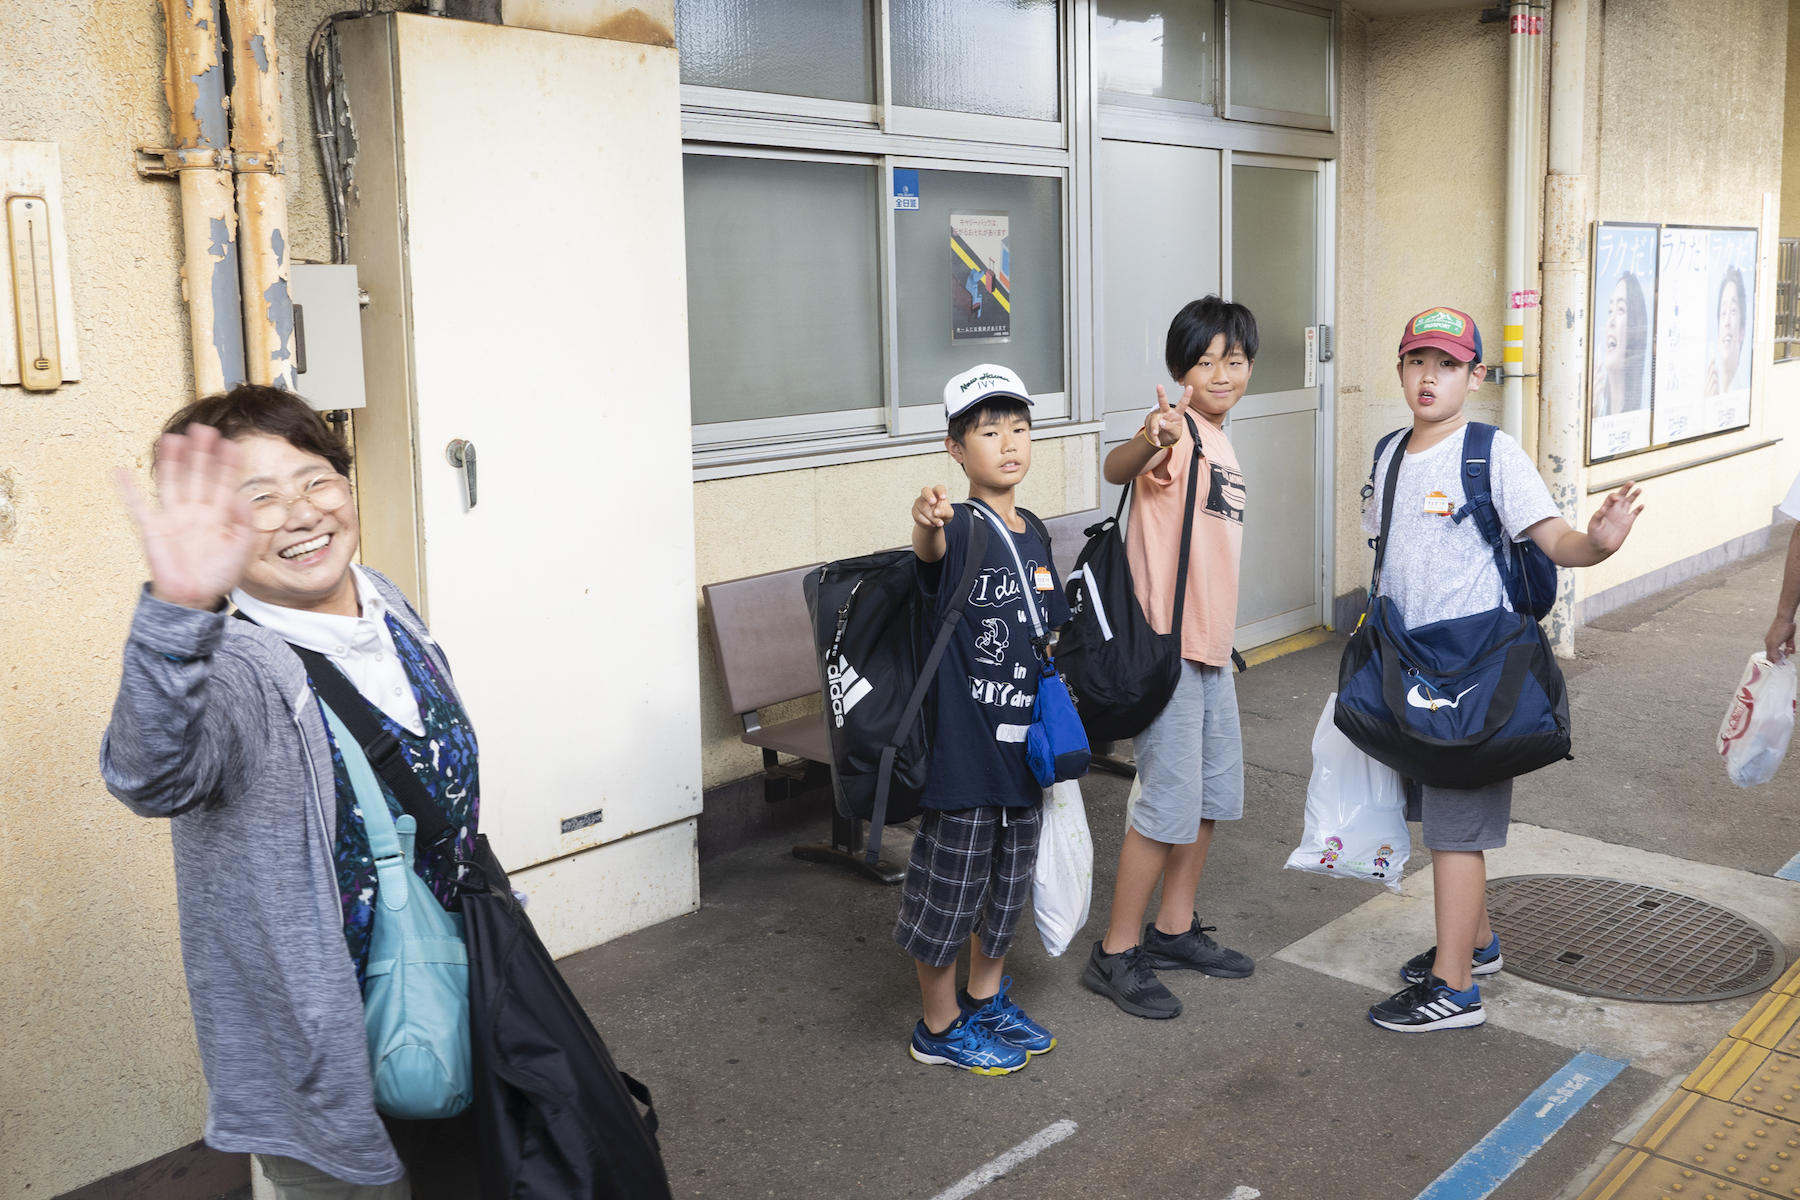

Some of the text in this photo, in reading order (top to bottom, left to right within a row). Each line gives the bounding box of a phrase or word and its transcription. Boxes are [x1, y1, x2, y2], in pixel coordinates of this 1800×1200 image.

[977, 380, 995, 390] IVY
[976, 575, 991, 601] I
[1013, 662, 1027, 679] in
[826, 649, 845, 729] didas
